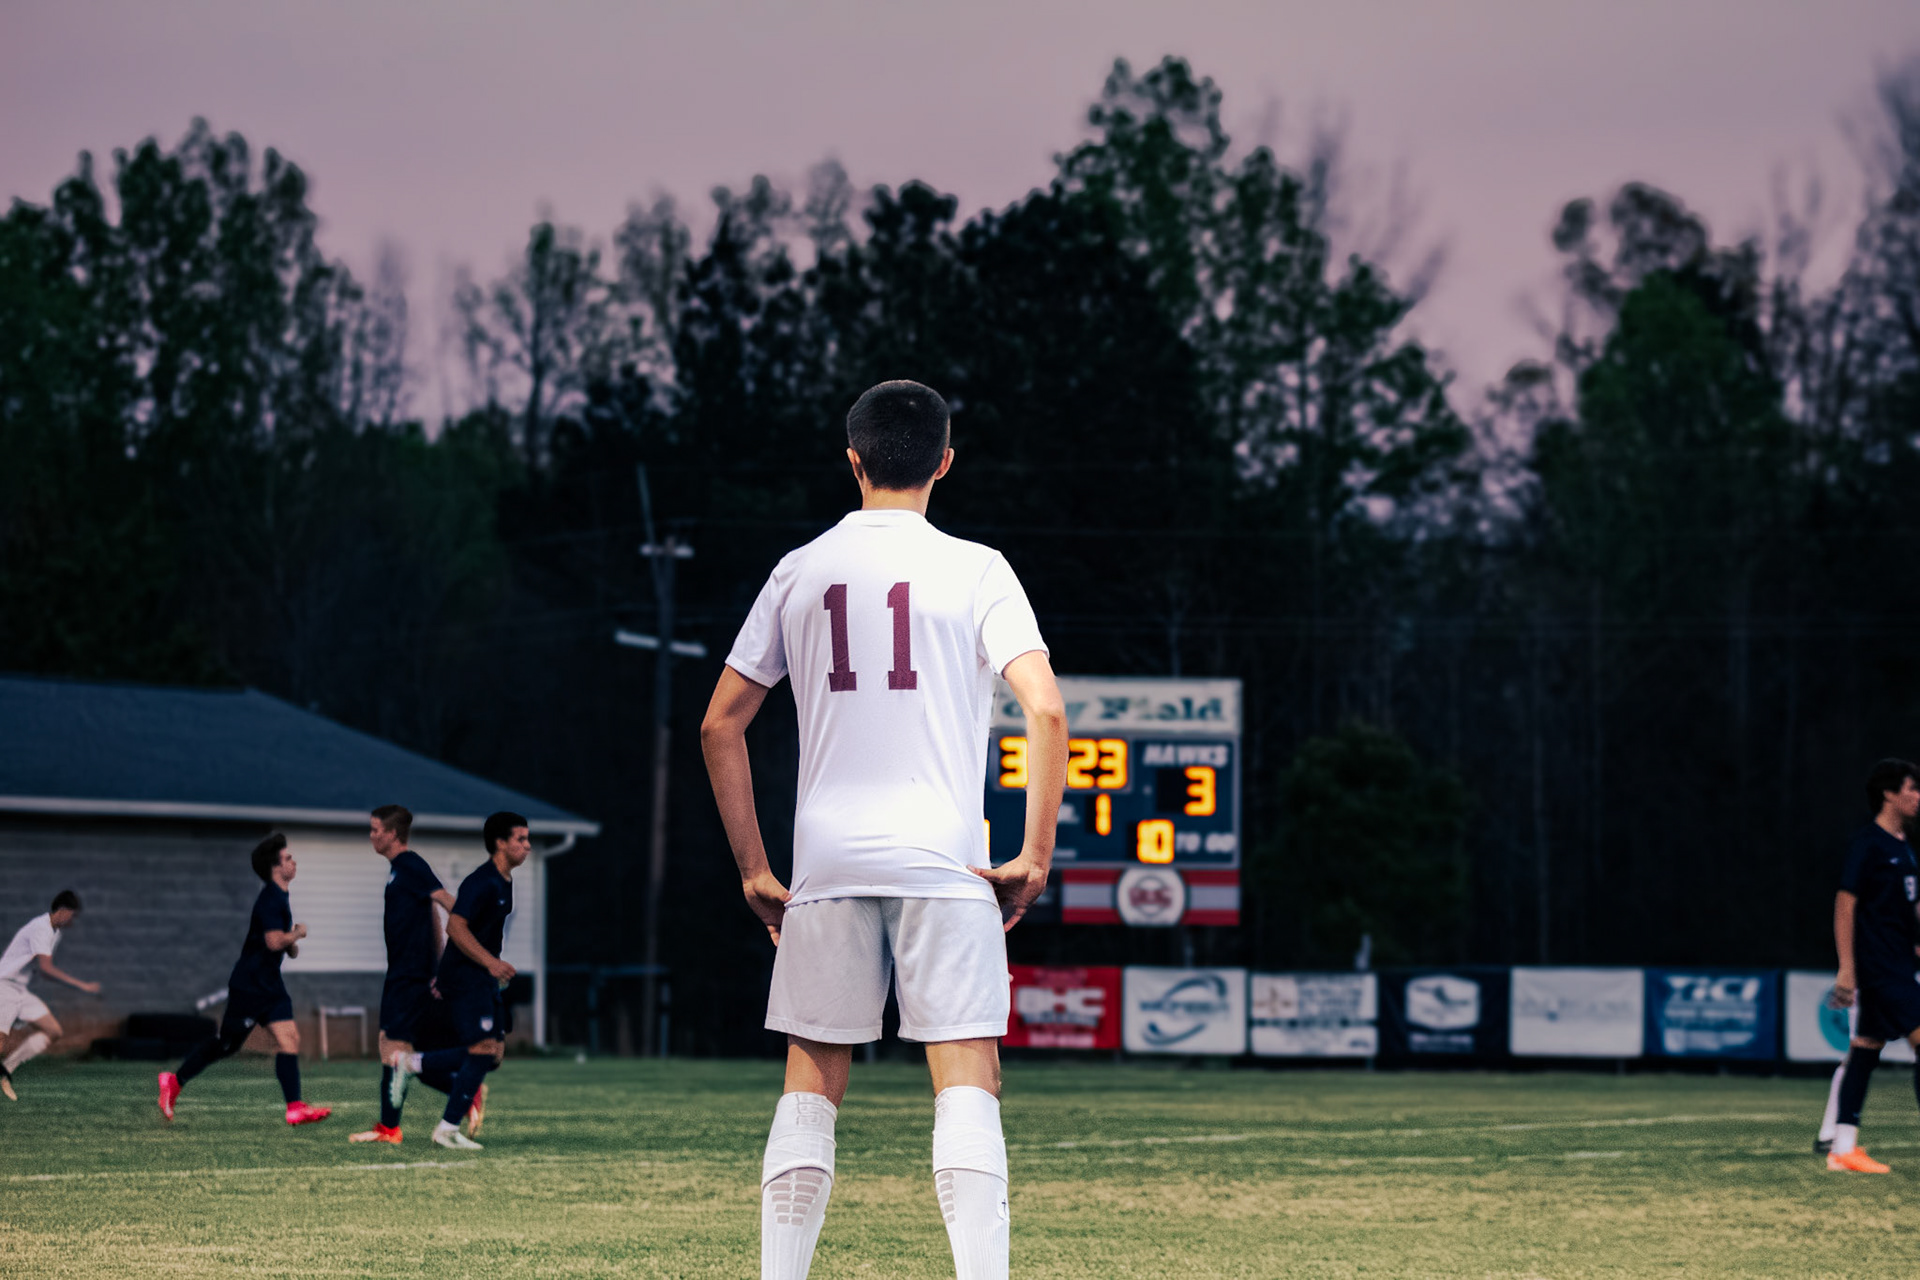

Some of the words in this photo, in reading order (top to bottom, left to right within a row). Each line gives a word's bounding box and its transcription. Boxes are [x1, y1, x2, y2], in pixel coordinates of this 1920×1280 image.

[823, 582, 917, 692] 11
[1095, 793, 1112, 836] 1
[1183, 766, 1216, 816] 3
